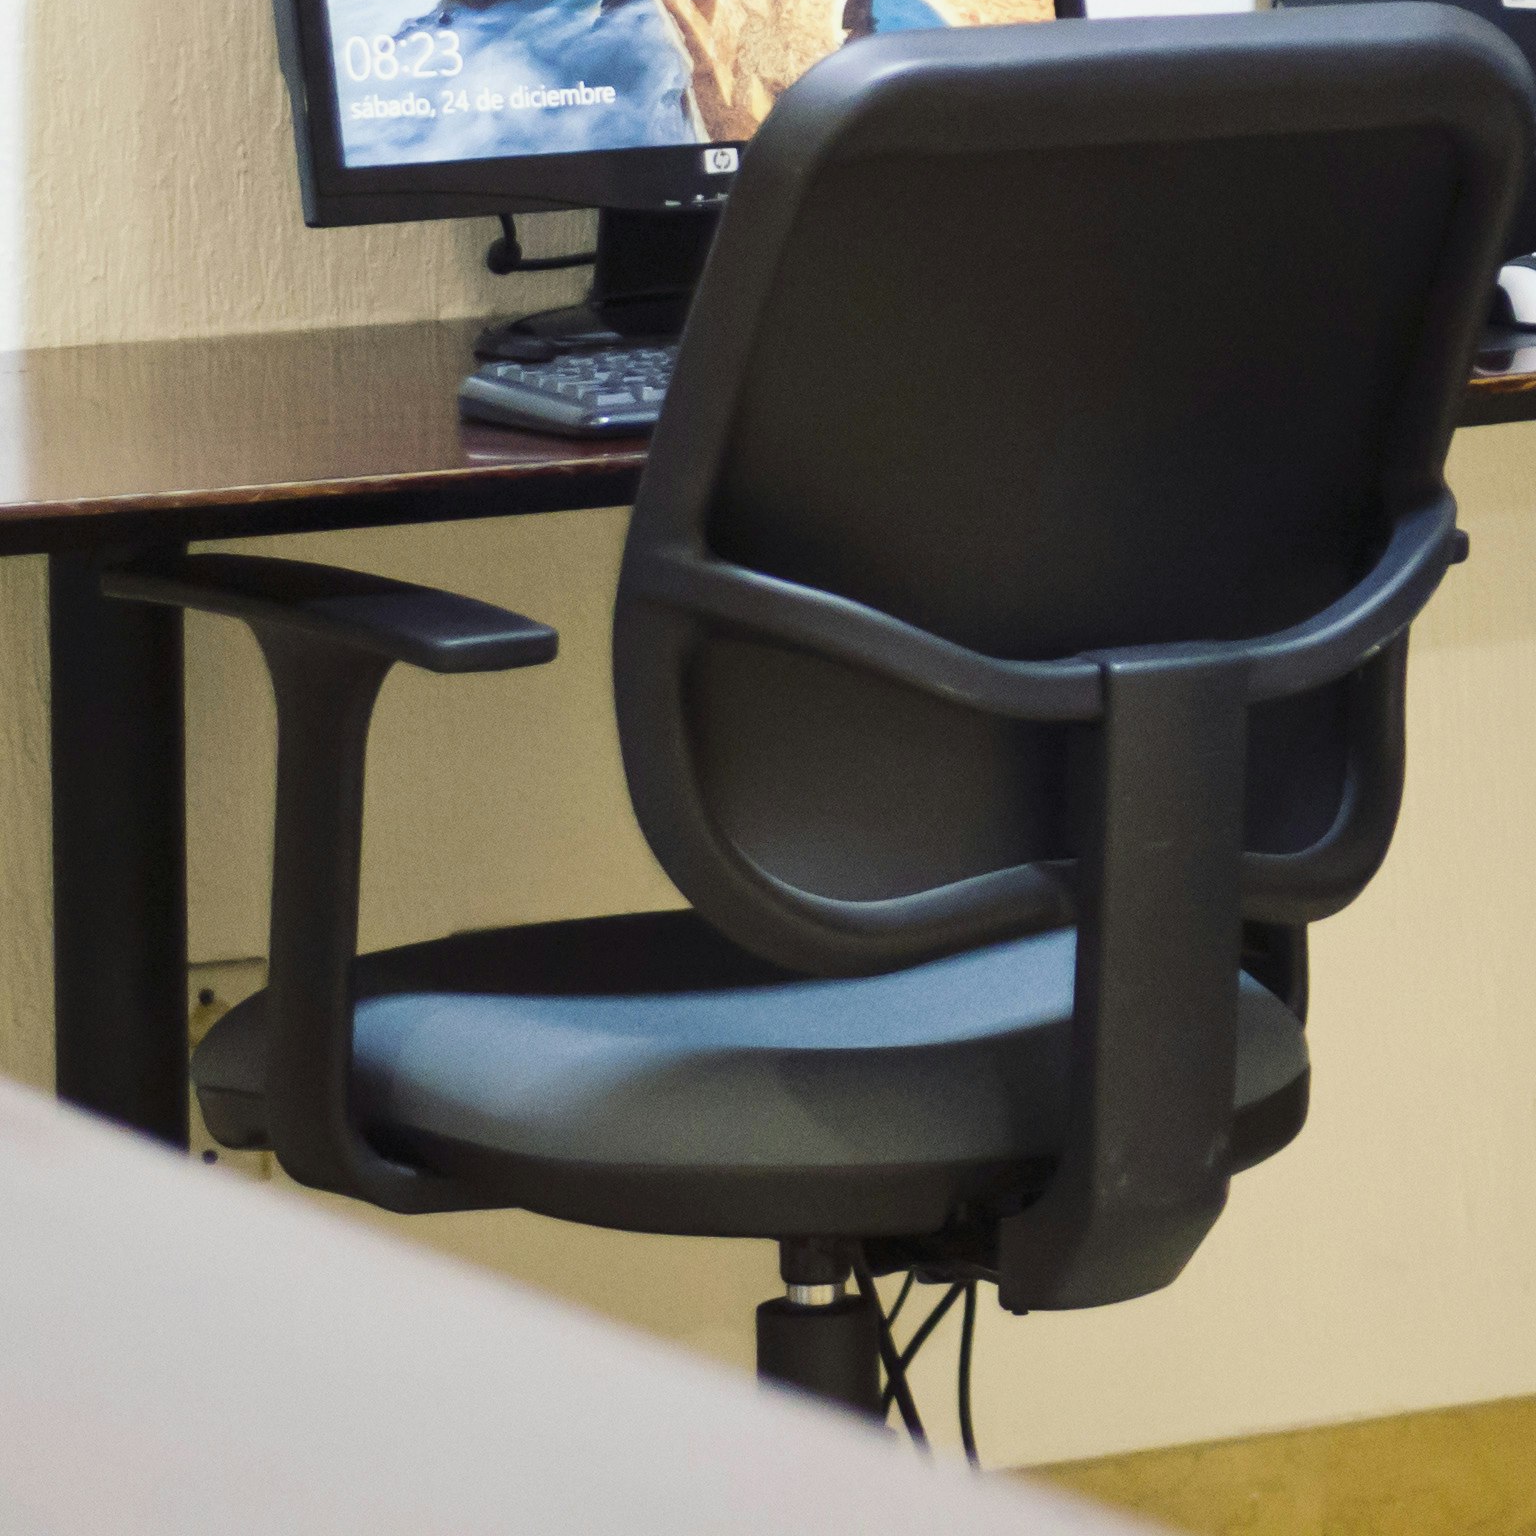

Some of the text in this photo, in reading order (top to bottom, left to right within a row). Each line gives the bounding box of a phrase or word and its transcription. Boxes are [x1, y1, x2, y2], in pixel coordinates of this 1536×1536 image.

[345, 30, 463, 82] 08:23
[350, 80, 616, 119] sábado, 24 de diciembre
